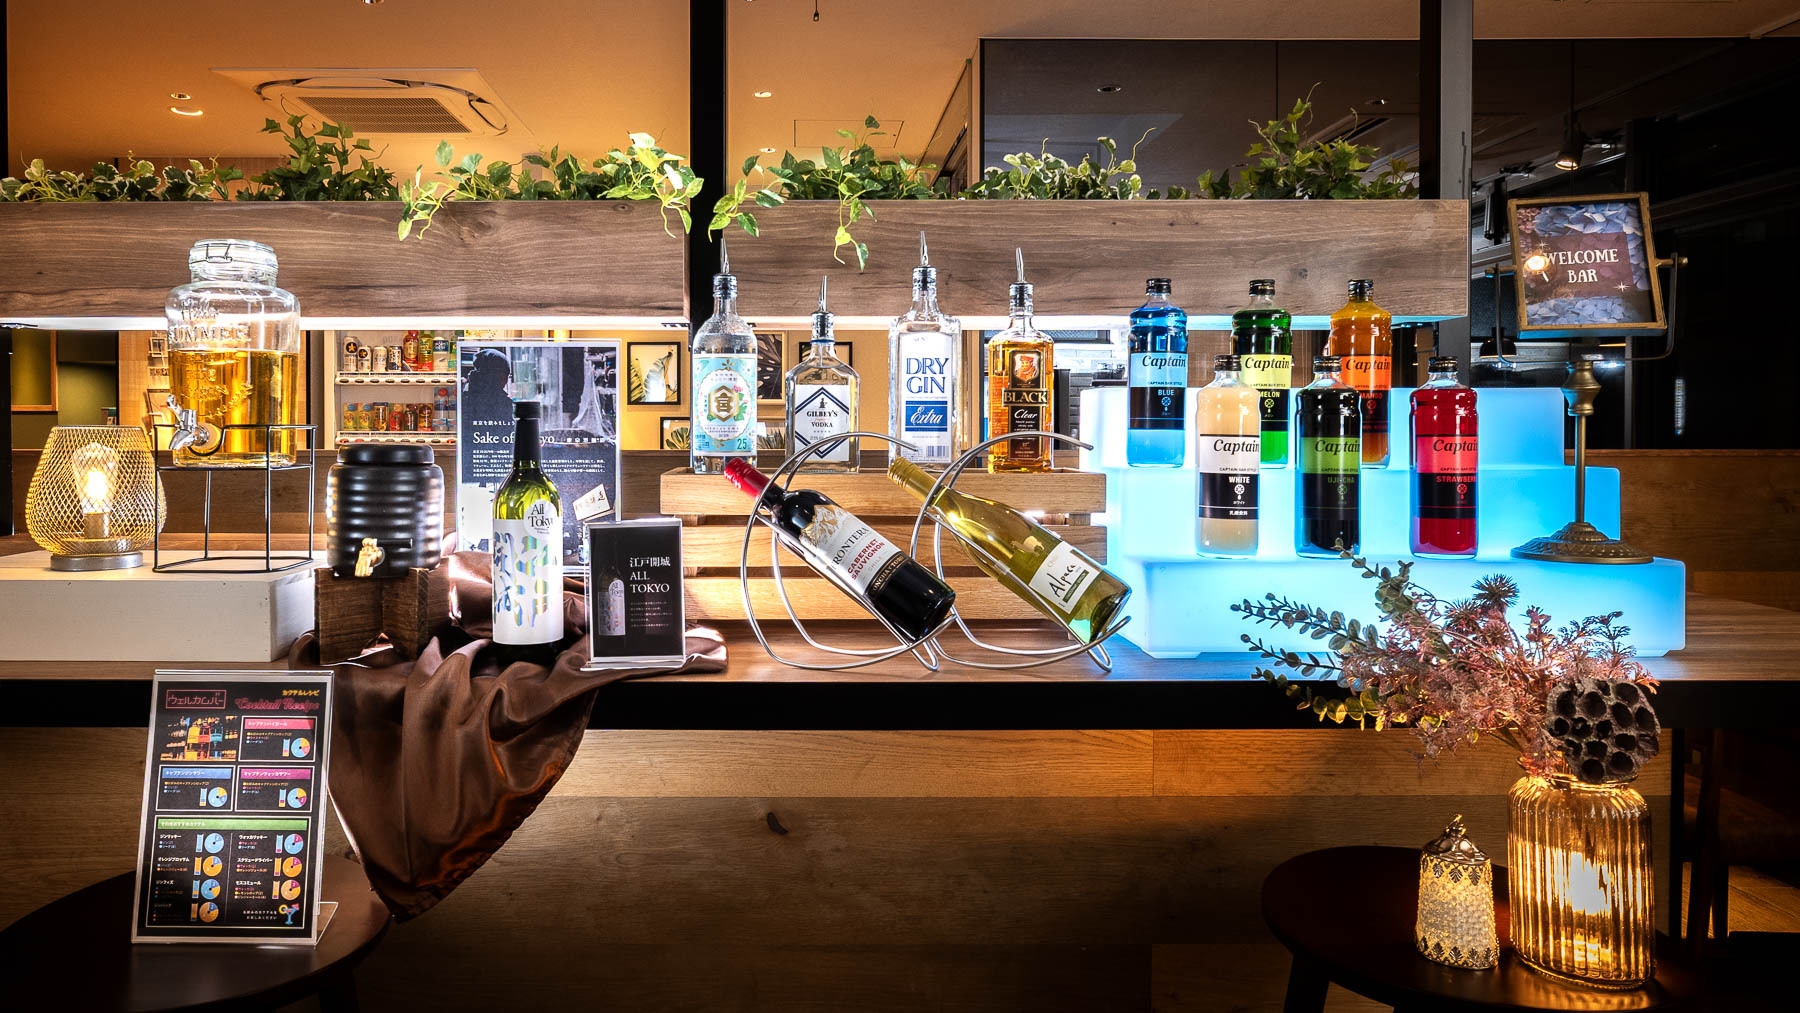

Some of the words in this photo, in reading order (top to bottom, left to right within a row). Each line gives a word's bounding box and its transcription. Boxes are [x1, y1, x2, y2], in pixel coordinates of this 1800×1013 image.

[1543, 248, 1619, 265] WELCOME
[1567, 269, 1599, 283] BAR
[905, 357, 950, 375] DRY
[1142, 354, 1186, 369] Captain
[1245, 356, 1290, 371] Captain
[906, 376, 946, 394] GIN
[1004, 391, 1047, 403] BLACK
[806, 409, 838, 418] GILBEY'S
[909, 405, 943, 426] Extra
[1014, 408, 1038, 419] Clear
[811, 421, 834, 429] VODKA
[472, 431, 500, 444] Sake
[502, 431, 516, 444] of
[737, 438, 748, 450] 25
[1213, 439, 1260, 455] Captain
[1228, 476, 1250, 484] WHITE
[530, 503, 546, 516] All
[629, 556, 671, 567] 江戸開城
[847, 538, 879, 574] CABERNET
[851, 541, 886, 581] SAUVIGNON
[629, 571, 650, 580] ALL
[1046, 563, 1078, 598] Alpaca
[629, 583, 670, 593] TOKYO
[168, 692, 224, 706] ウェルカムバー
[282, 689, 321, 697] カクテルレシピ
